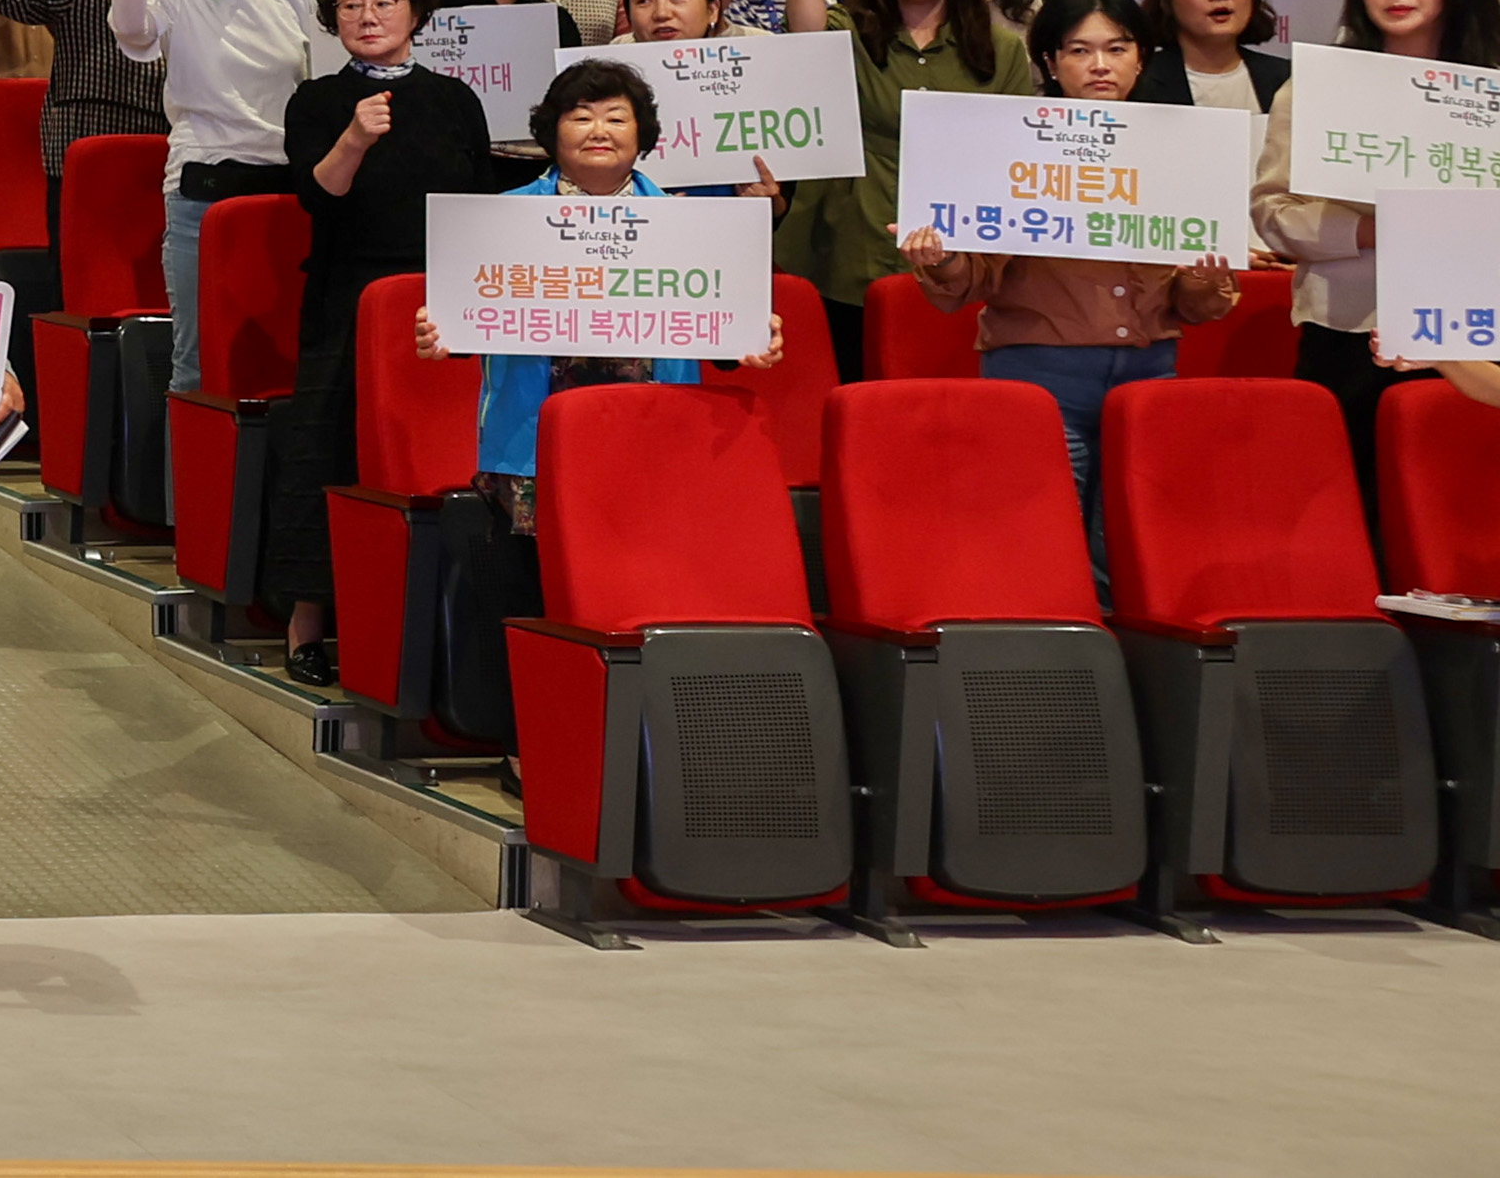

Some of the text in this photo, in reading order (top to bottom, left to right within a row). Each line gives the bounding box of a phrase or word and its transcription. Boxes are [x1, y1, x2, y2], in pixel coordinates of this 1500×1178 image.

[714, 107, 824, 153] ZERO!
[1321, 130, 1415, 178] 모두가
[1008, 161, 1139, 205] 언제든지
[1086, 211, 1218, 252] 함께해요!
[473, 264, 722, 299] 생활불편ZERO!
